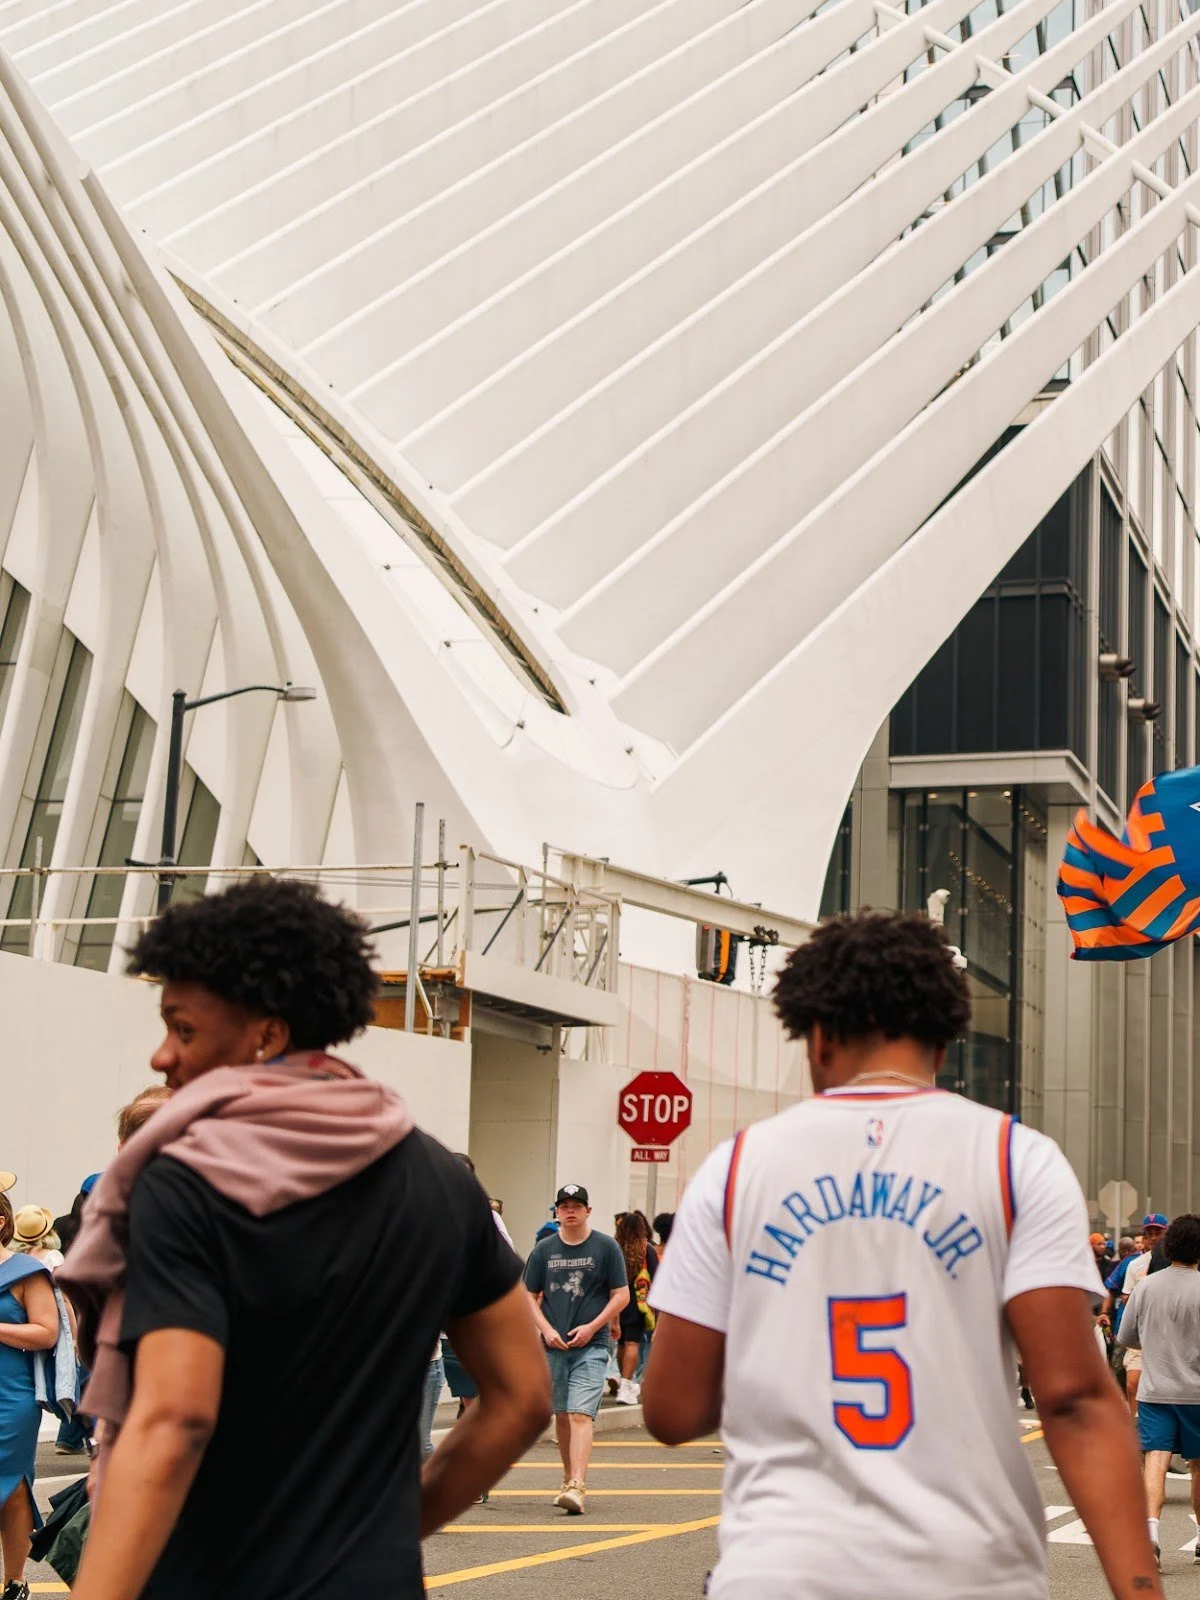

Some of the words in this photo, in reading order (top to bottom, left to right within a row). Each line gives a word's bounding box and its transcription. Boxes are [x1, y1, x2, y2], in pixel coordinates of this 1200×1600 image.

[622, 1093, 690, 1123] STOP
[633, 1150, 651, 1161] ALL
[653, 1150, 669, 1161] WAY
[744, 1170, 944, 1286] HARDAWAY
[922, 1212, 986, 1281] JR.
[827, 1291, 916, 1451] 5
